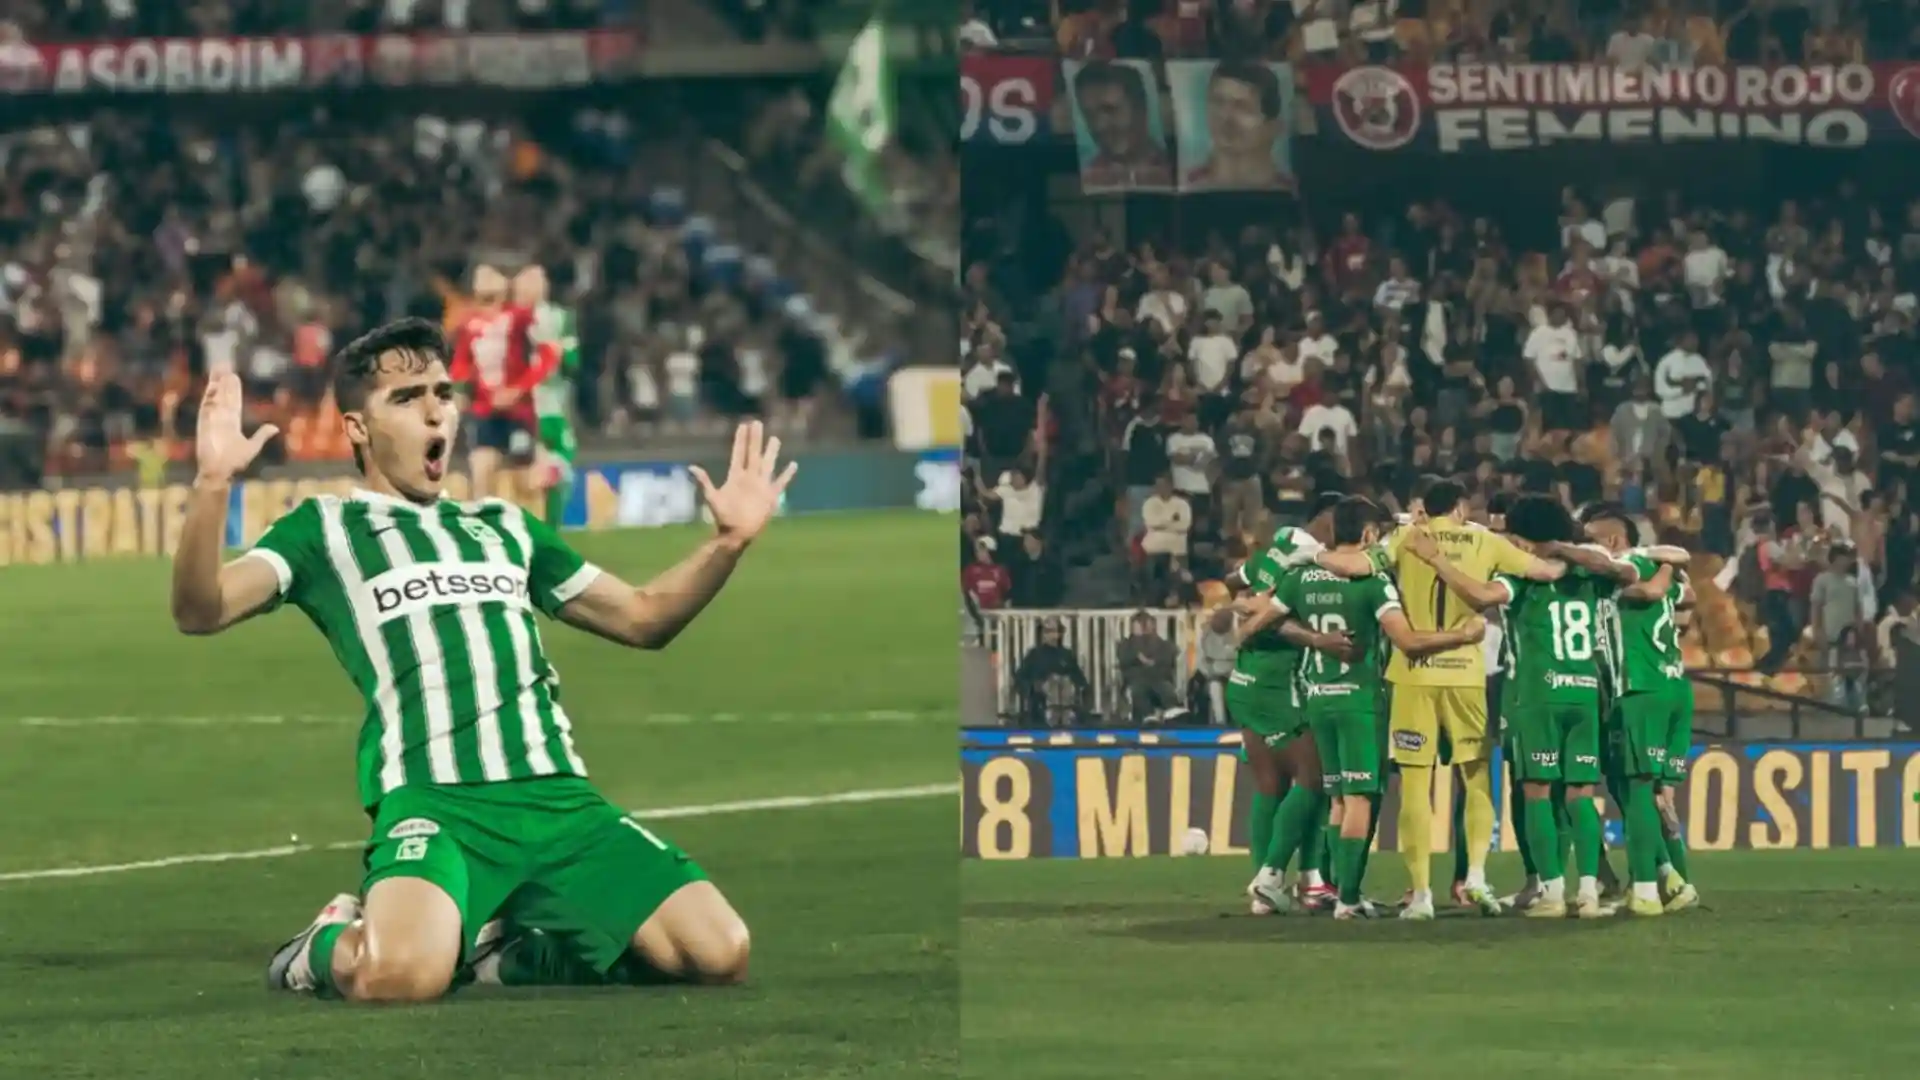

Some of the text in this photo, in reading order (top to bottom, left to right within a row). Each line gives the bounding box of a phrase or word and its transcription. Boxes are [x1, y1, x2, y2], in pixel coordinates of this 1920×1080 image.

[1427, 63, 1727, 105] SENTIMIENTO
[1734, 63, 1874, 107] ROJO
[1435, 108, 1870, 152] FEMENINO
[1547, 600, 1593, 661] 18
